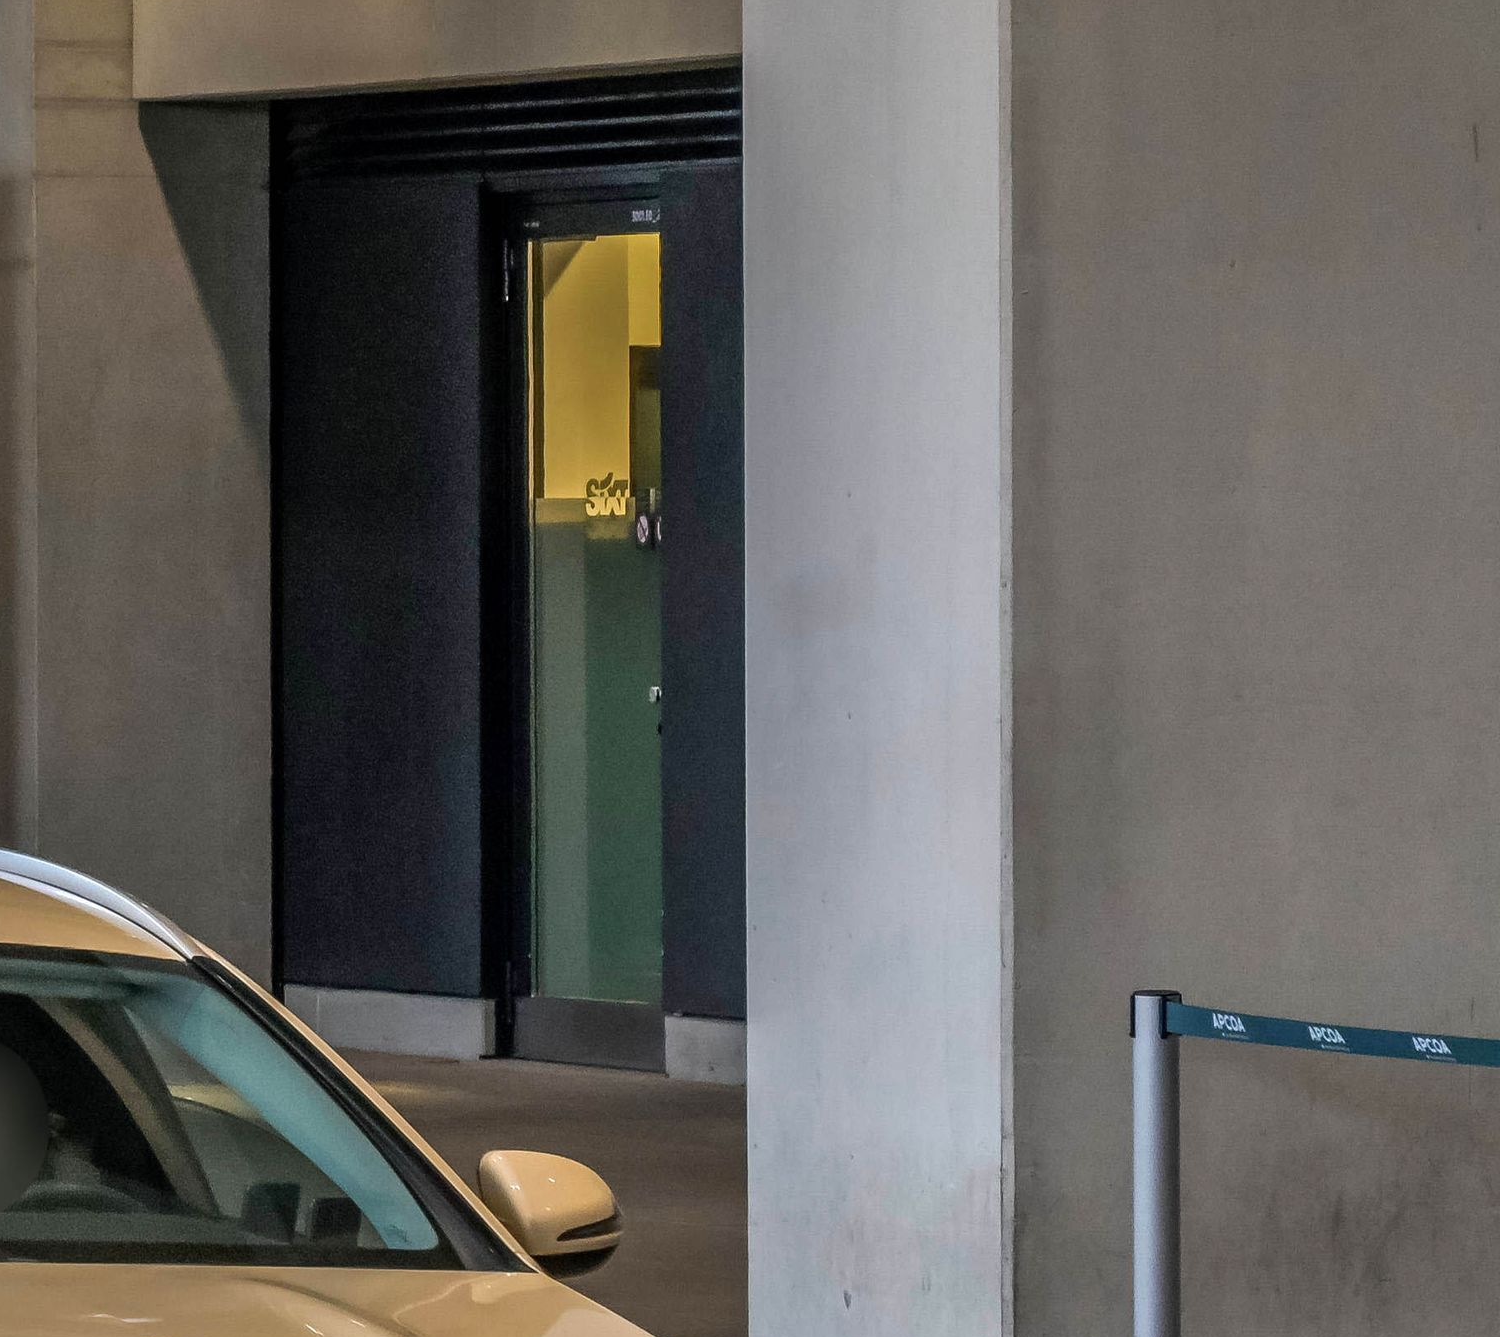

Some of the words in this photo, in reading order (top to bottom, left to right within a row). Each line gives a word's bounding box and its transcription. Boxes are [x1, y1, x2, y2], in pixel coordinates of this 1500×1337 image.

[1212, 1012, 1246, 1032] APCOA
[1308, 1025, 1346, 1044] APCOA
[1412, 1036, 1452, 1054] APCOA
